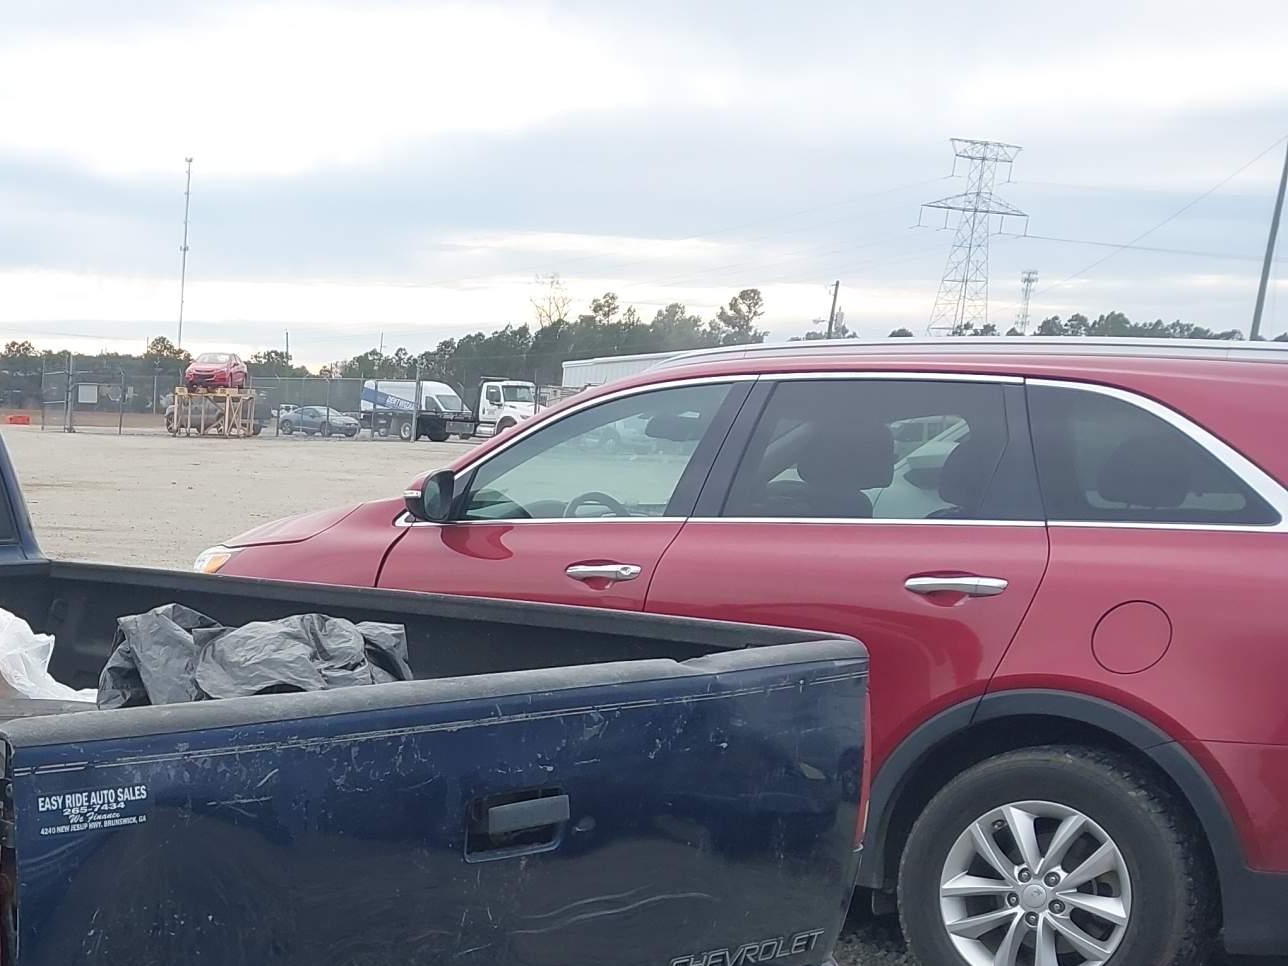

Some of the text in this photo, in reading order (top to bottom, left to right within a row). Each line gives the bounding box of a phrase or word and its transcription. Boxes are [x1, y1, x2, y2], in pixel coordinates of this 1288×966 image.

[38, 785, 147, 812] EASY RIDE AUTO SALES
[63, 801, 125, 815] 265-7434
[56, 824, 70, 833] NEW
[138, 815, 147, 823] GA
[68, 811, 120, 824] We Finance
